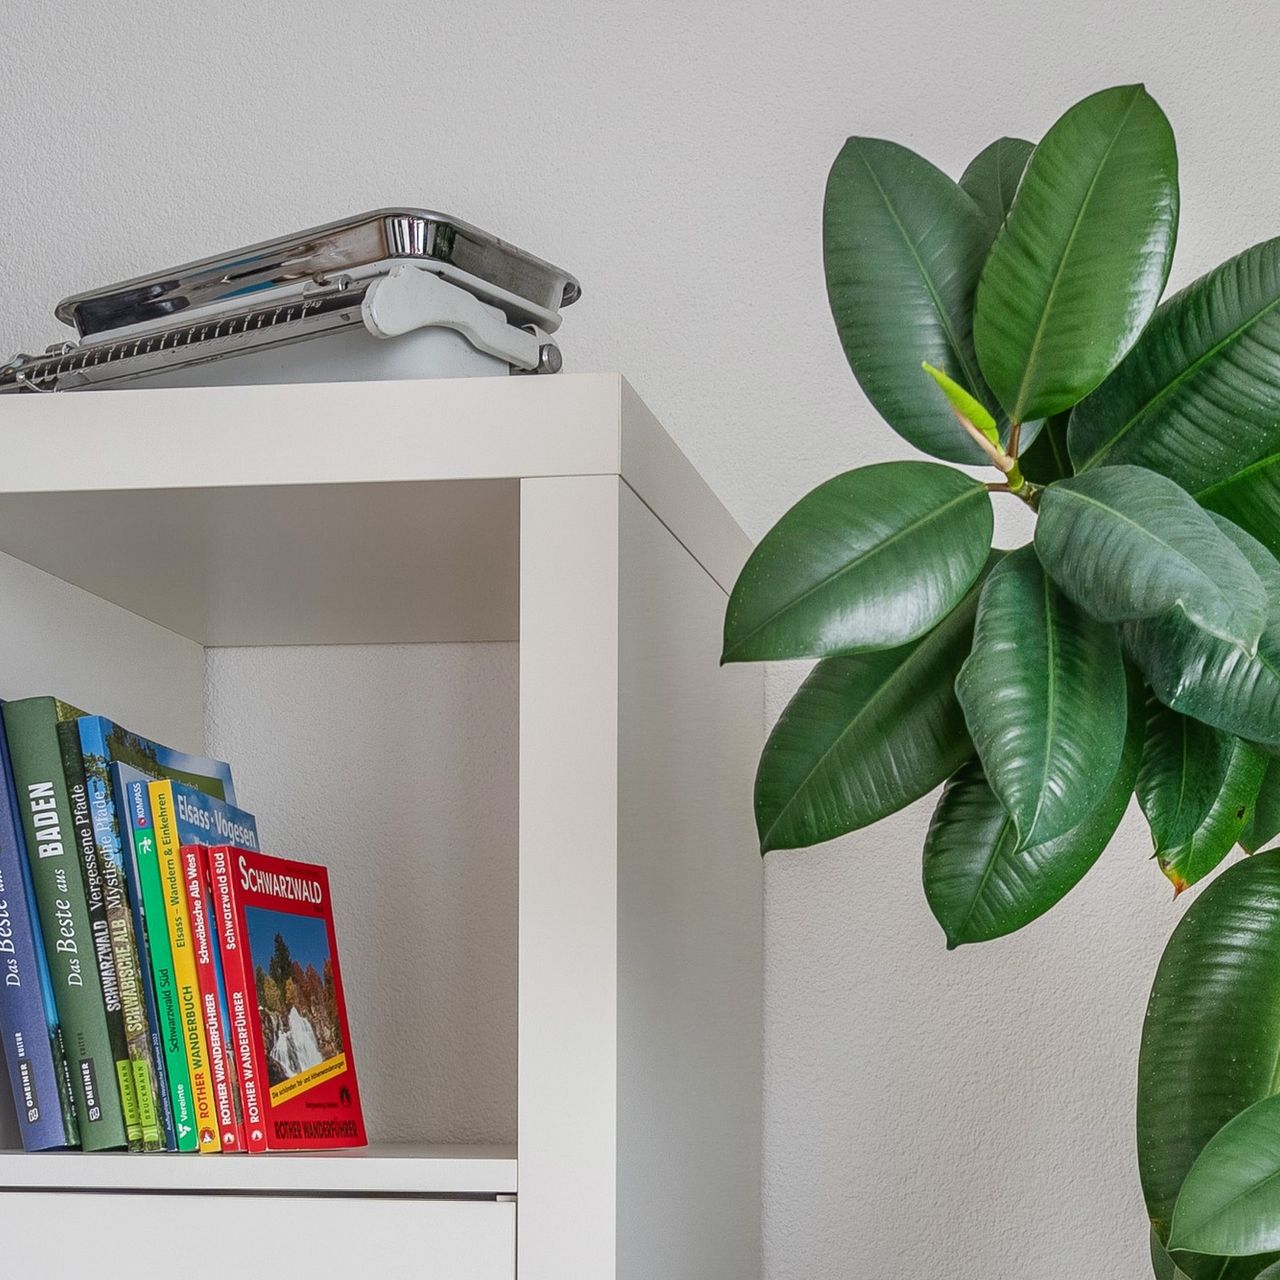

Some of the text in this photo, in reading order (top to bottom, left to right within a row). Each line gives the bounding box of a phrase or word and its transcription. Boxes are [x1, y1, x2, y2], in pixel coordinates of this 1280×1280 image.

[28, 782, 64, 859] BADEN
[133, 782, 146, 818] KOMPASS
[158, 793, 171, 846] Einkehren
[177, 795, 257, 849] Elsass Vogesen
[71, 784, 121, 1012] SCHWARZWALD Vergessene Pfade
[164, 859, 181, 907] Wandern
[214, 852, 237, 950] Schwarzwald Süd
[238, 855, 323, 904] SCHWARZWALD
[54, 868, 84, 988] Das Beste aus
[92, 790, 143, 1032] SCHWÄBISCHE ALB Mystische Pfade
[176, 917, 186, 948] Elsass
[186, 853, 210, 965] Schwäbische Alb West
[5, 958, 21, 988] Das
[157, 968, 180, 1053] Schwarzwald Süd
[182, 986, 210, 1119] ROTHER WANDERBUCH
[205, 993, 232, 1126] ROTHER WANDERFÜHRER
[233, 992, 260, 1123] ROTHER WANDERFÜHRER
[20, 1063, 34, 1108] GMEINER
[81, 1062, 95, 1107] GMEINER
[121, 1065, 136, 1119] BRUCKMANN
[137, 1065, 151, 1120] BRUCKMANN
[177, 1084, 187, 1123] Vereinte
